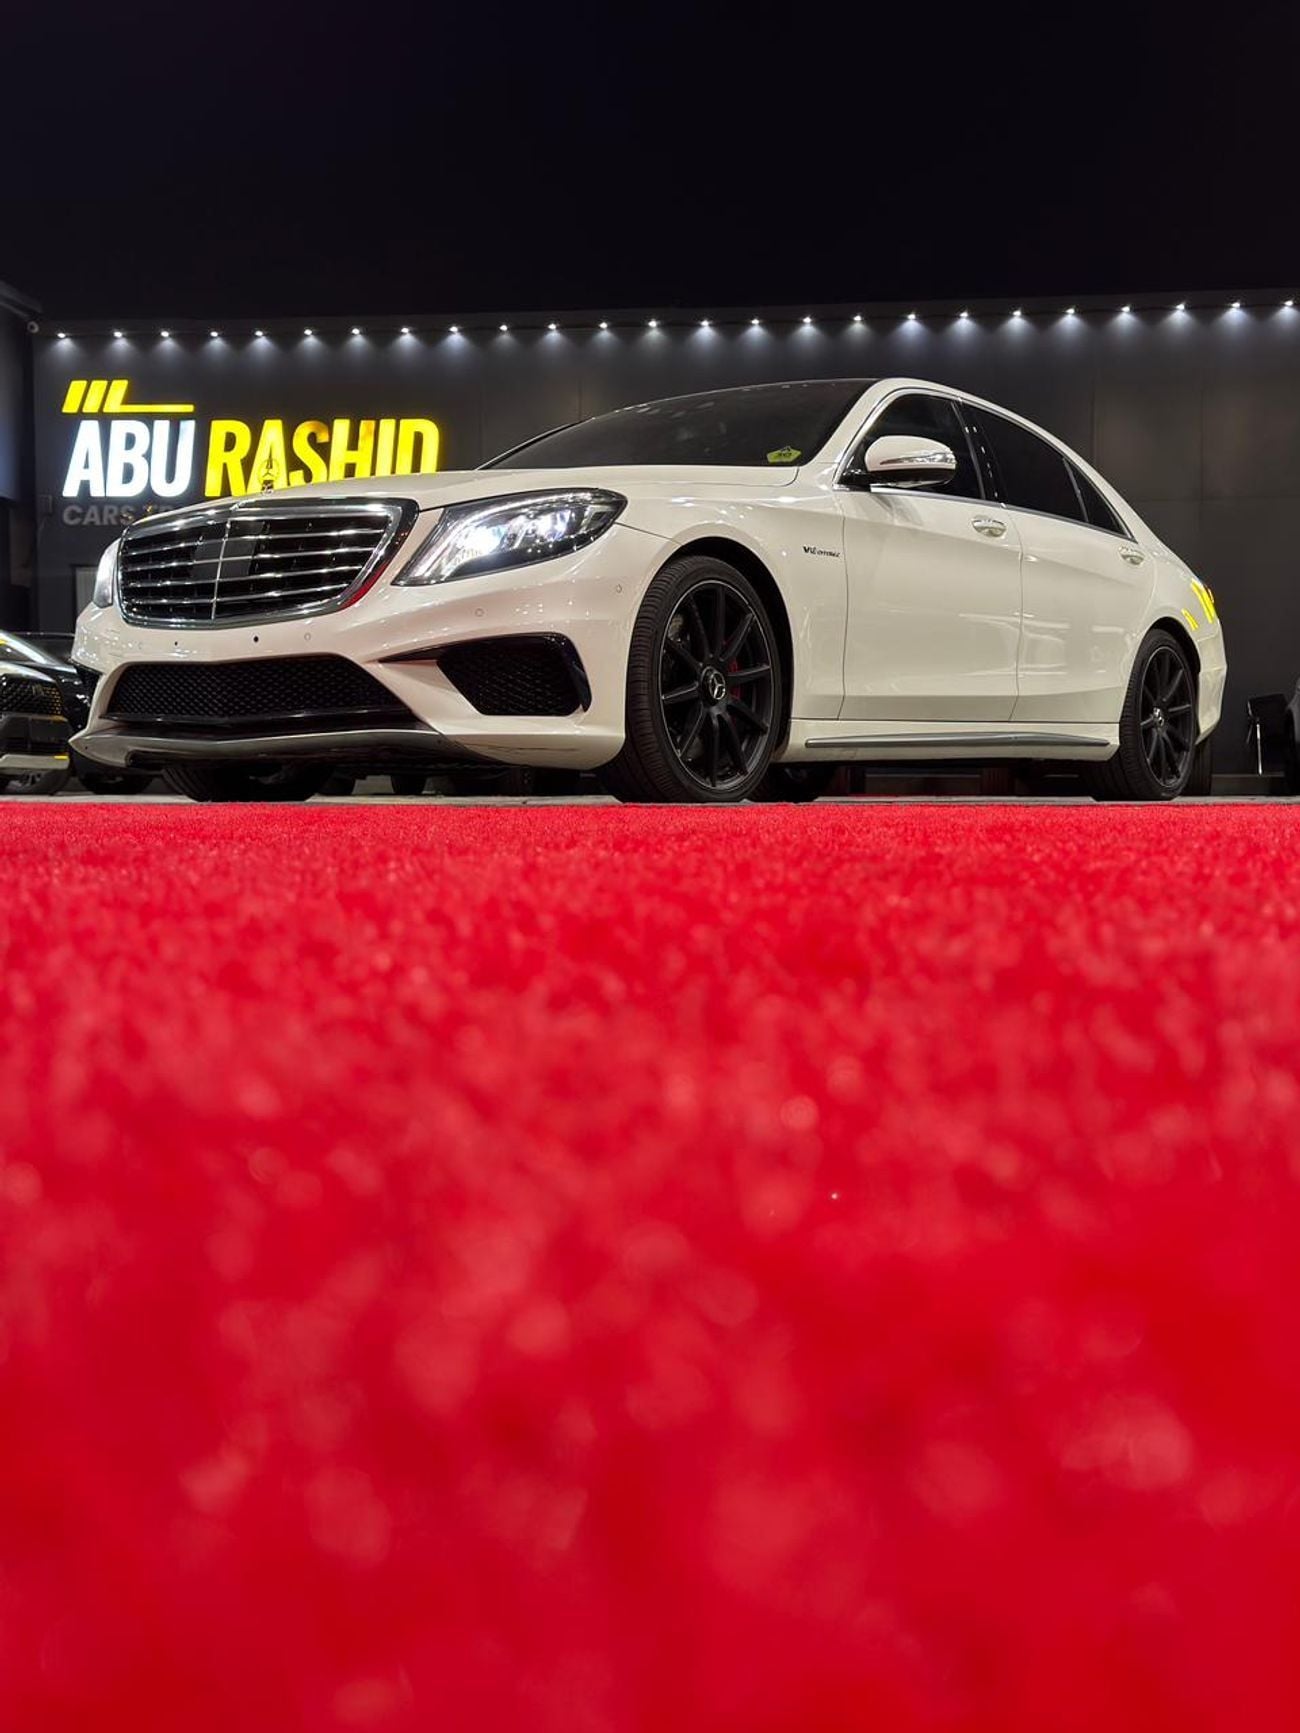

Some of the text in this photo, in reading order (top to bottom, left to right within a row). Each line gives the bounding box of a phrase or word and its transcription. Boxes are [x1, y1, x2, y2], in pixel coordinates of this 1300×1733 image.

[62, 418, 440, 498] ABU RASHID
[62, 504, 135, 526] CARS
